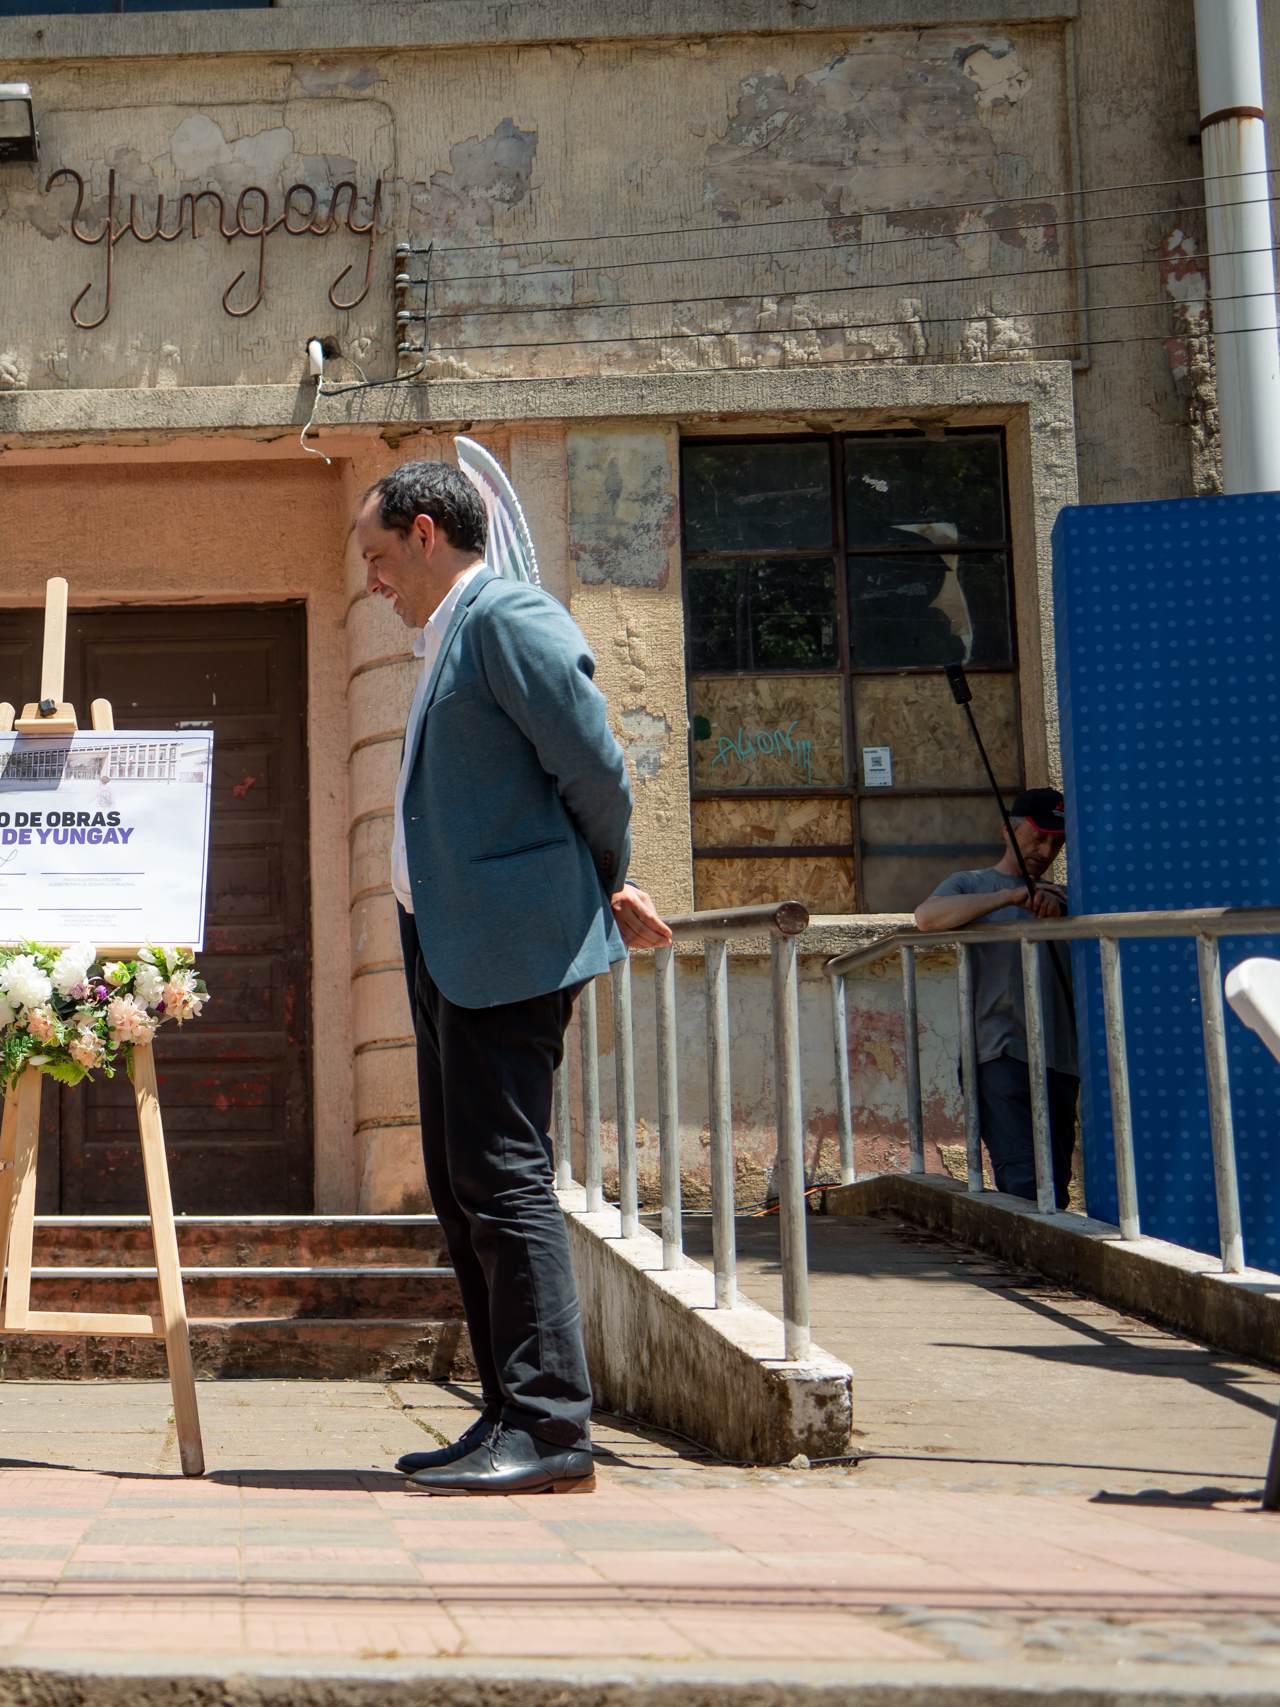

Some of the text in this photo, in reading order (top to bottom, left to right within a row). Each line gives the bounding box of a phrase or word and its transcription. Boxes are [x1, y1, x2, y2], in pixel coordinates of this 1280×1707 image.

[45, 168, 383, 329] Yungay
[15, 812, 42, 827] DE
[46, 811, 121, 827] OBRAS
[2, 828, 32, 845] DE
[36, 827, 134, 845] YUNGAY
